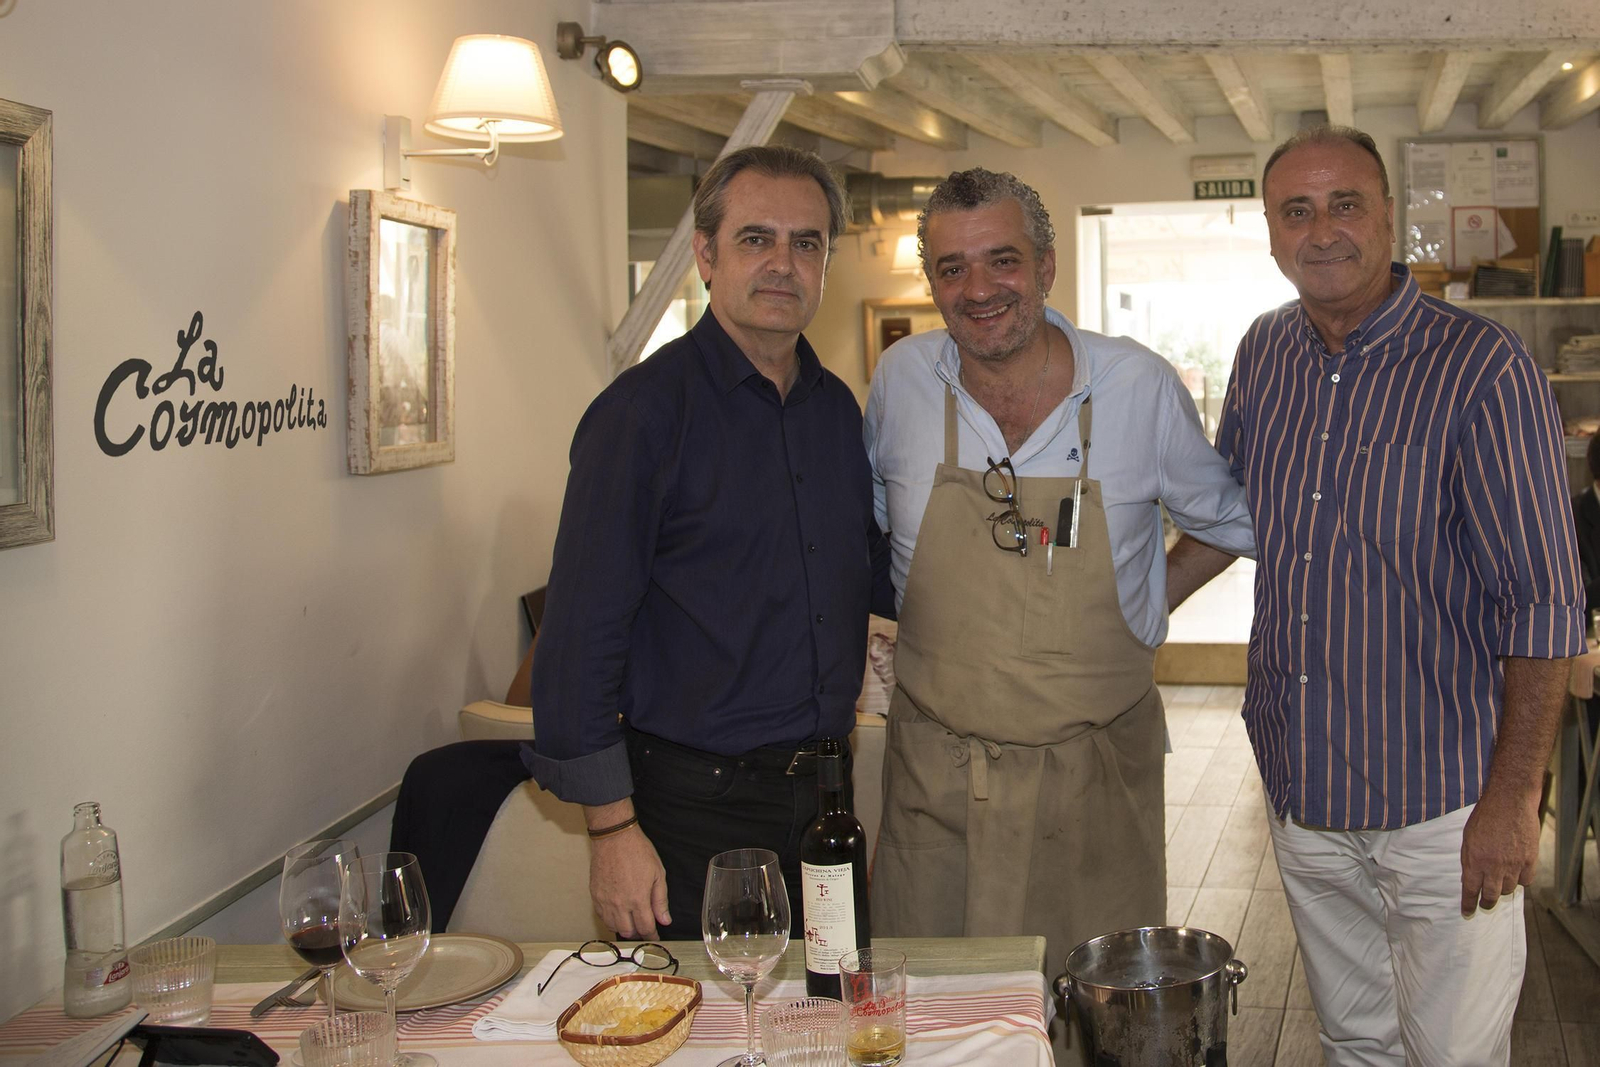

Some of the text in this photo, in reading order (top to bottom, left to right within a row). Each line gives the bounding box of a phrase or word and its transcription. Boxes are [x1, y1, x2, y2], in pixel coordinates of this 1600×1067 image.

[1198, 181, 1252, 197] SALIDA
[152, 310, 225, 396] La
[93, 357, 328, 458] Cosmopolita
